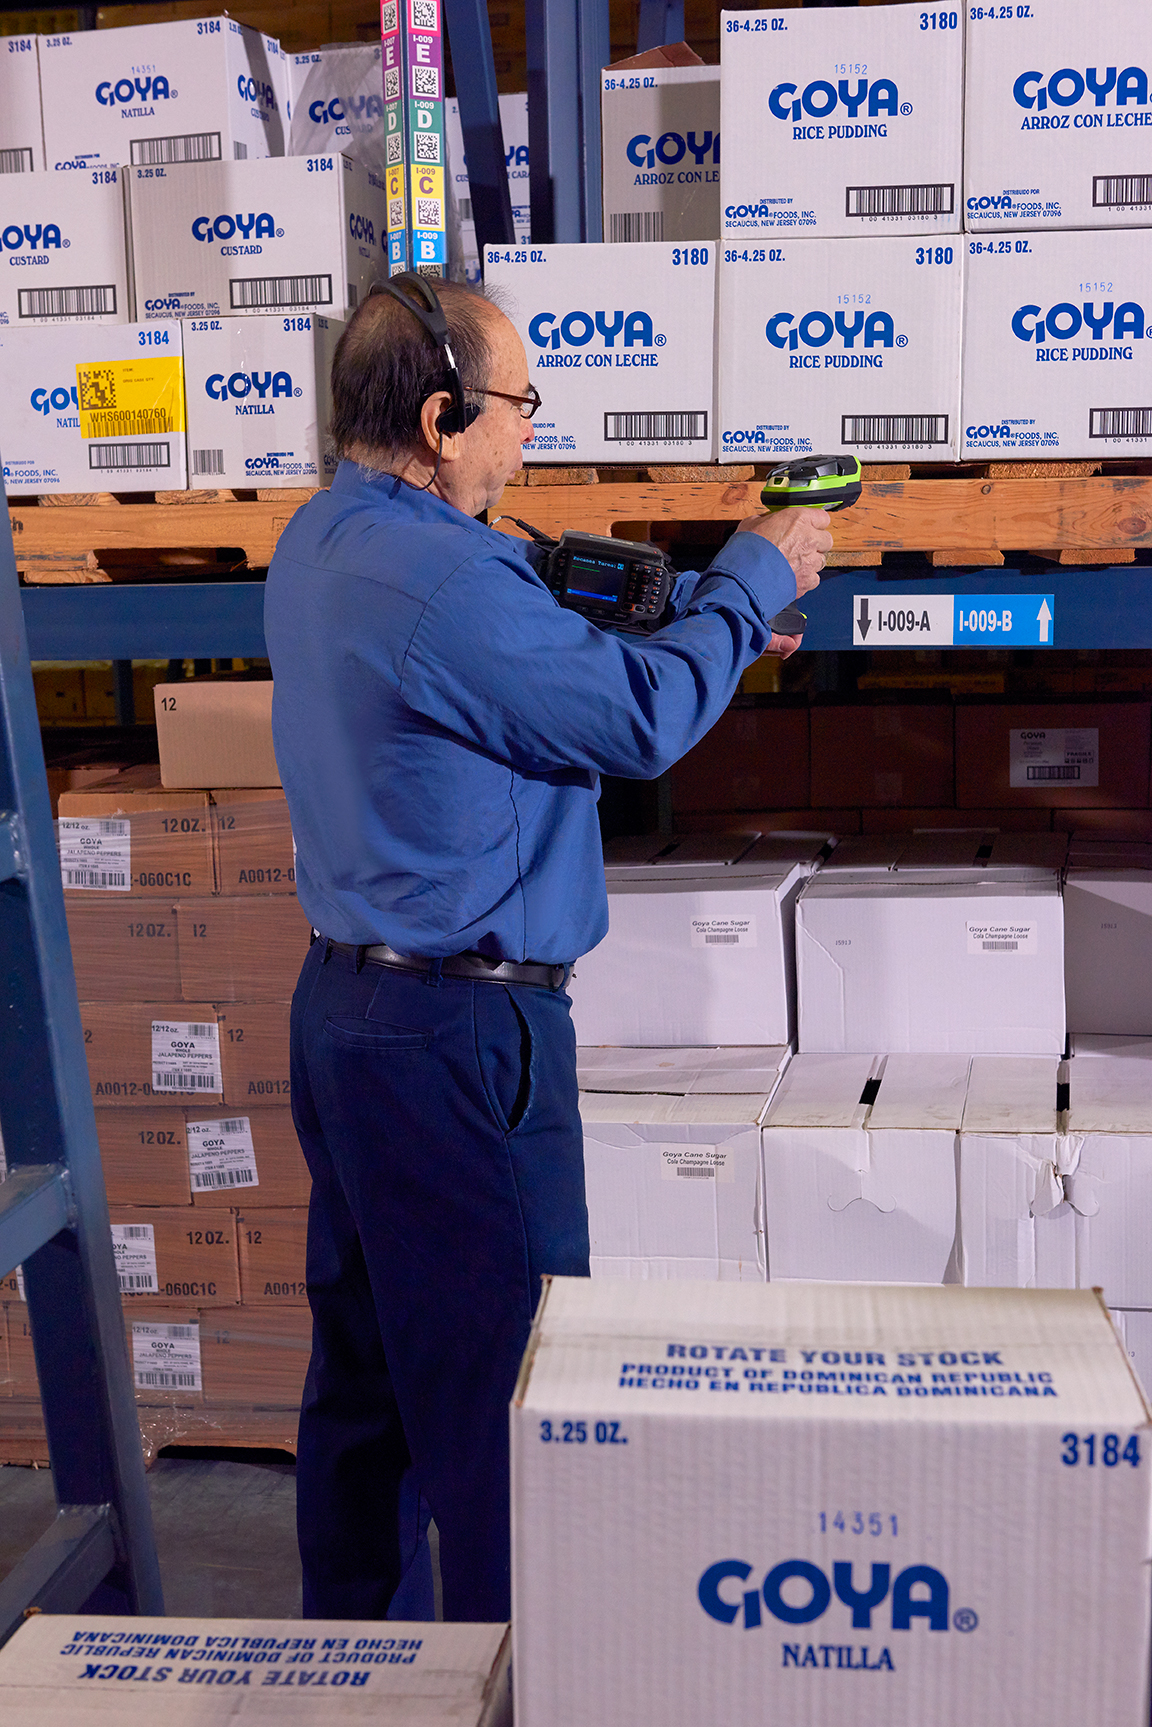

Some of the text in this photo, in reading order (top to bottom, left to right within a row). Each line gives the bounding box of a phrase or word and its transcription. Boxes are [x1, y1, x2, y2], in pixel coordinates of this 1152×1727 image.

[970, 6, 1034, 20] 36-4.25 OZ.
[197, 20, 221, 35] 3184
[726, 18, 788, 33] 36-4.25 OZ.
[919, 12, 957, 30] 3180
[8, 39, 32, 53] 3184
[413, 35, 433, 43] I-009
[386, 46, 394, 66] E
[417, 44, 430, 63] E
[834, 64, 868, 75] 15152
[604, 77, 658, 90] 36-4.25 OZ.
[415, 101, 434, 109] I-009
[121, 107, 155, 118] NATILLA
[418, 110, 432, 128] D
[388, 112, 397, 131] D
[1021, 112, 1152, 130] ARROZ CON LECHE
[792, 124, 888, 140] RICE PUDDING
[307, 158, 333, 173] 3184
[416, 167, 435, 175] I-009
[92, 171, 117, 184] 3184
[137, 168, 167, 178] 3.25 OZ.
[634, 172, 703, 185] ARROZ CON
[391, 177, 398, 195] C
[419, 177, 433, 194] C
[967, 211, 1002, 219] SECAUCUS,
[725, 220, 759, 228] SECAUCUS,
[221, 245, 262, 256] CUSTARD
[392, 242, 401, 260] B
[421, 241, 435, 259] B
[969, 241, 1032, 254] 36-4.25 OZ.
[9, 255, 49, 266] CUSTARD
[487, 251, 546, 263] 36-4.25 OZ.
[672, 248, 708, 265] 3180
[725, 249, 785, 262] 36-4.25 OZ.
[916, 247, 953, 265] 3180
[1079, 282, 1113, 293] 15152
[837, 294, 871, 304] 15152
[191, 321, 222, 331] 3.25 OZ.
[284, 318, 311, 331] 3184
[138, 331, 169, 345] 3184
[537, 354, 658, 367] ARROZ CON LECHE
[1036, 347, 1133, 361] RICE PUDDING
[789, 355, 883, 368] RICE PUDDING
[90, 408, 166, 422] WHS600140760
[235, 404, 275, 415] NATILLA
[57, 417, 80, 428] NATIL
[1015, 431, 1059, 440] FOODS, INC.
[878, 610, 931, 632] I-009-A
[959, 610, 1012, 631] I-009-B
[161, 698, 177, 711] 12
[218, 817, 235, 830] 12
[239, 869, 295, 884] A0012-0
[192, 924, 207, 937] 12
[227, 1029, 244, 1042] 12
[679, 1158, 709, 1166] Champagne
[246, 1232, 262, 1245] 12
[667, 1343, 1003, 1366] ROTATE YOUR STOCK
[621, 1363, 1053, 1384] PRODUCT OF DOMINICAN REPUBLIC
[618, 1377, 1057, 1398] HECHO EN REPUBLICA DOMINICANA
[539, 1421, 628, 1444] 3.25 OZ.
[1061, 1433, 1140, 1467] 3184
[818, 1510, 900, 1536] 14351
[72, 1631, 423, 1651] HECHO EN REPUBLICA DOMINICANA
[60, 1644, 417, 1664] PRODUCT OF DOMINICAN REPUBLIC
[781, 1643, 895, 1672] NATILLA
[77, 1663, 371, 1687] ROTATE YOUR STOCK
